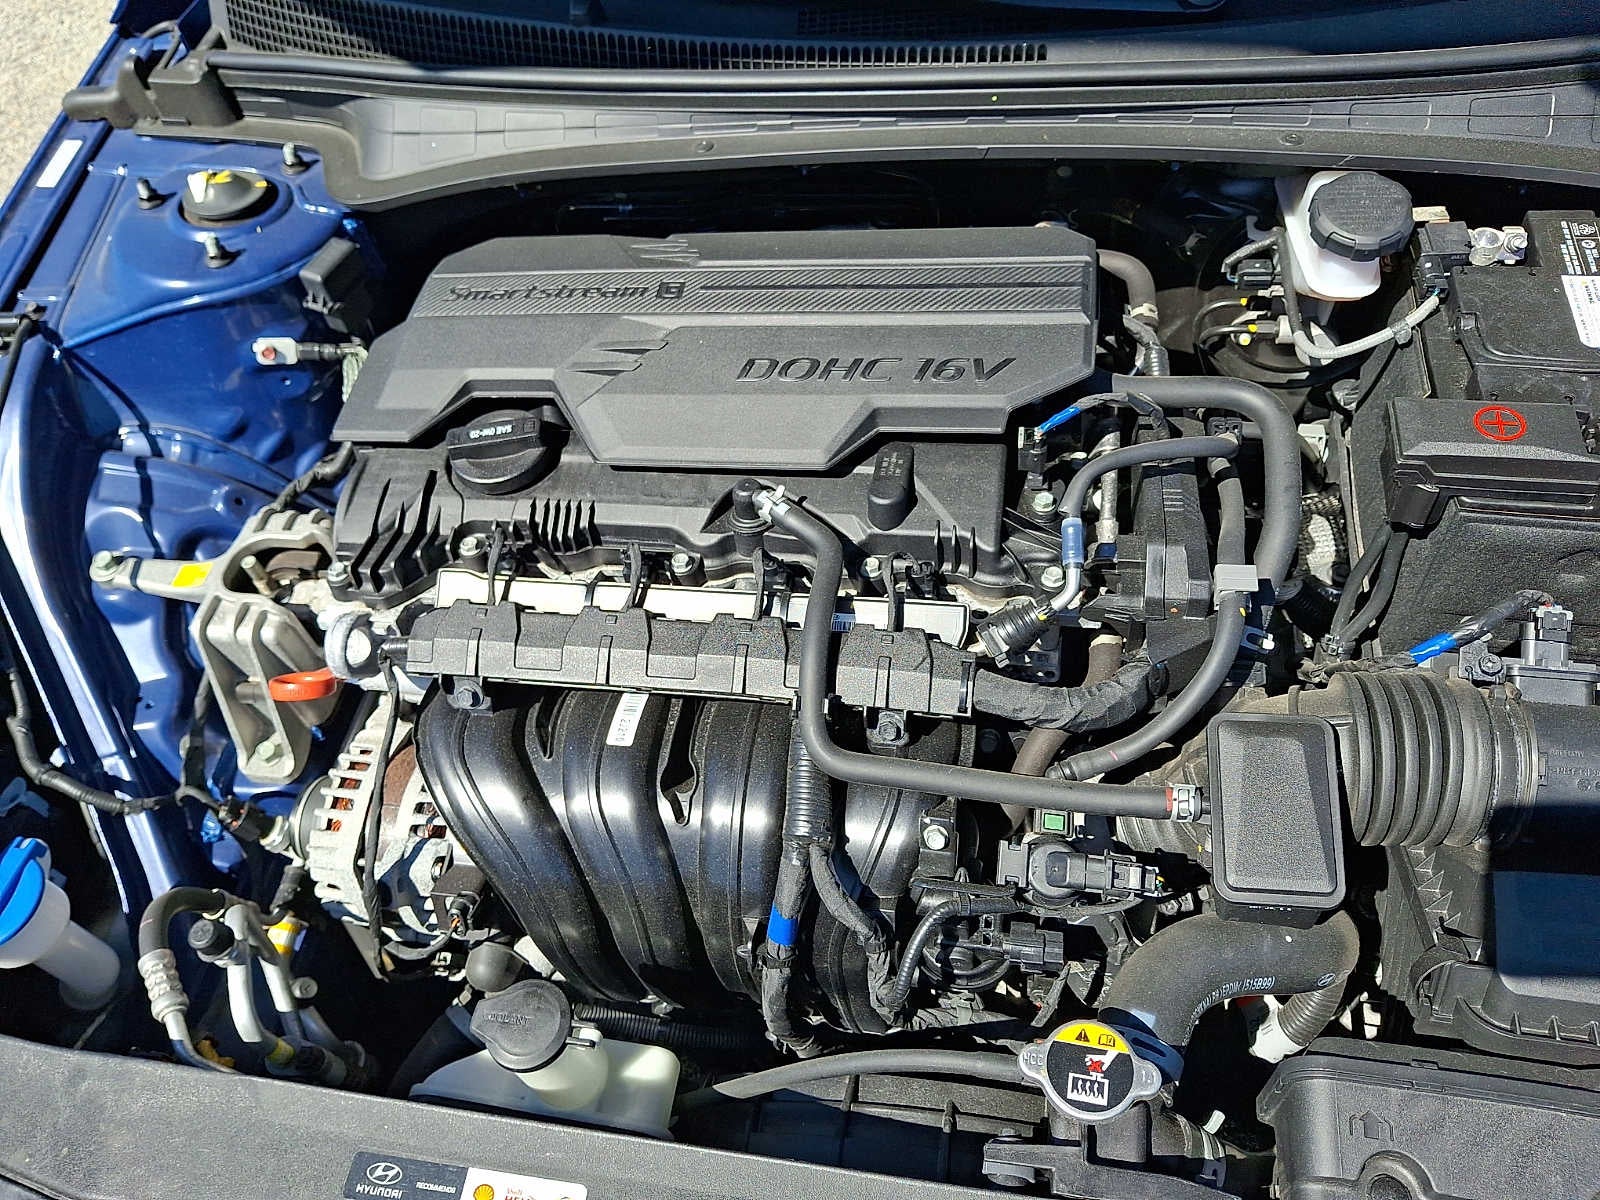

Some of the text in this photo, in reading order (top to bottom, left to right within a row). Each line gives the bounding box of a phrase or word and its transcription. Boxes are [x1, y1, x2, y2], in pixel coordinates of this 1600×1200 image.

[450, 284, 650, 300] Smartstream
[735, 356, 1018, 385] DOHC 16V
[495, 424, 514, 435] SAE
[355, 1183, 403, 1200] HYUNDAI
